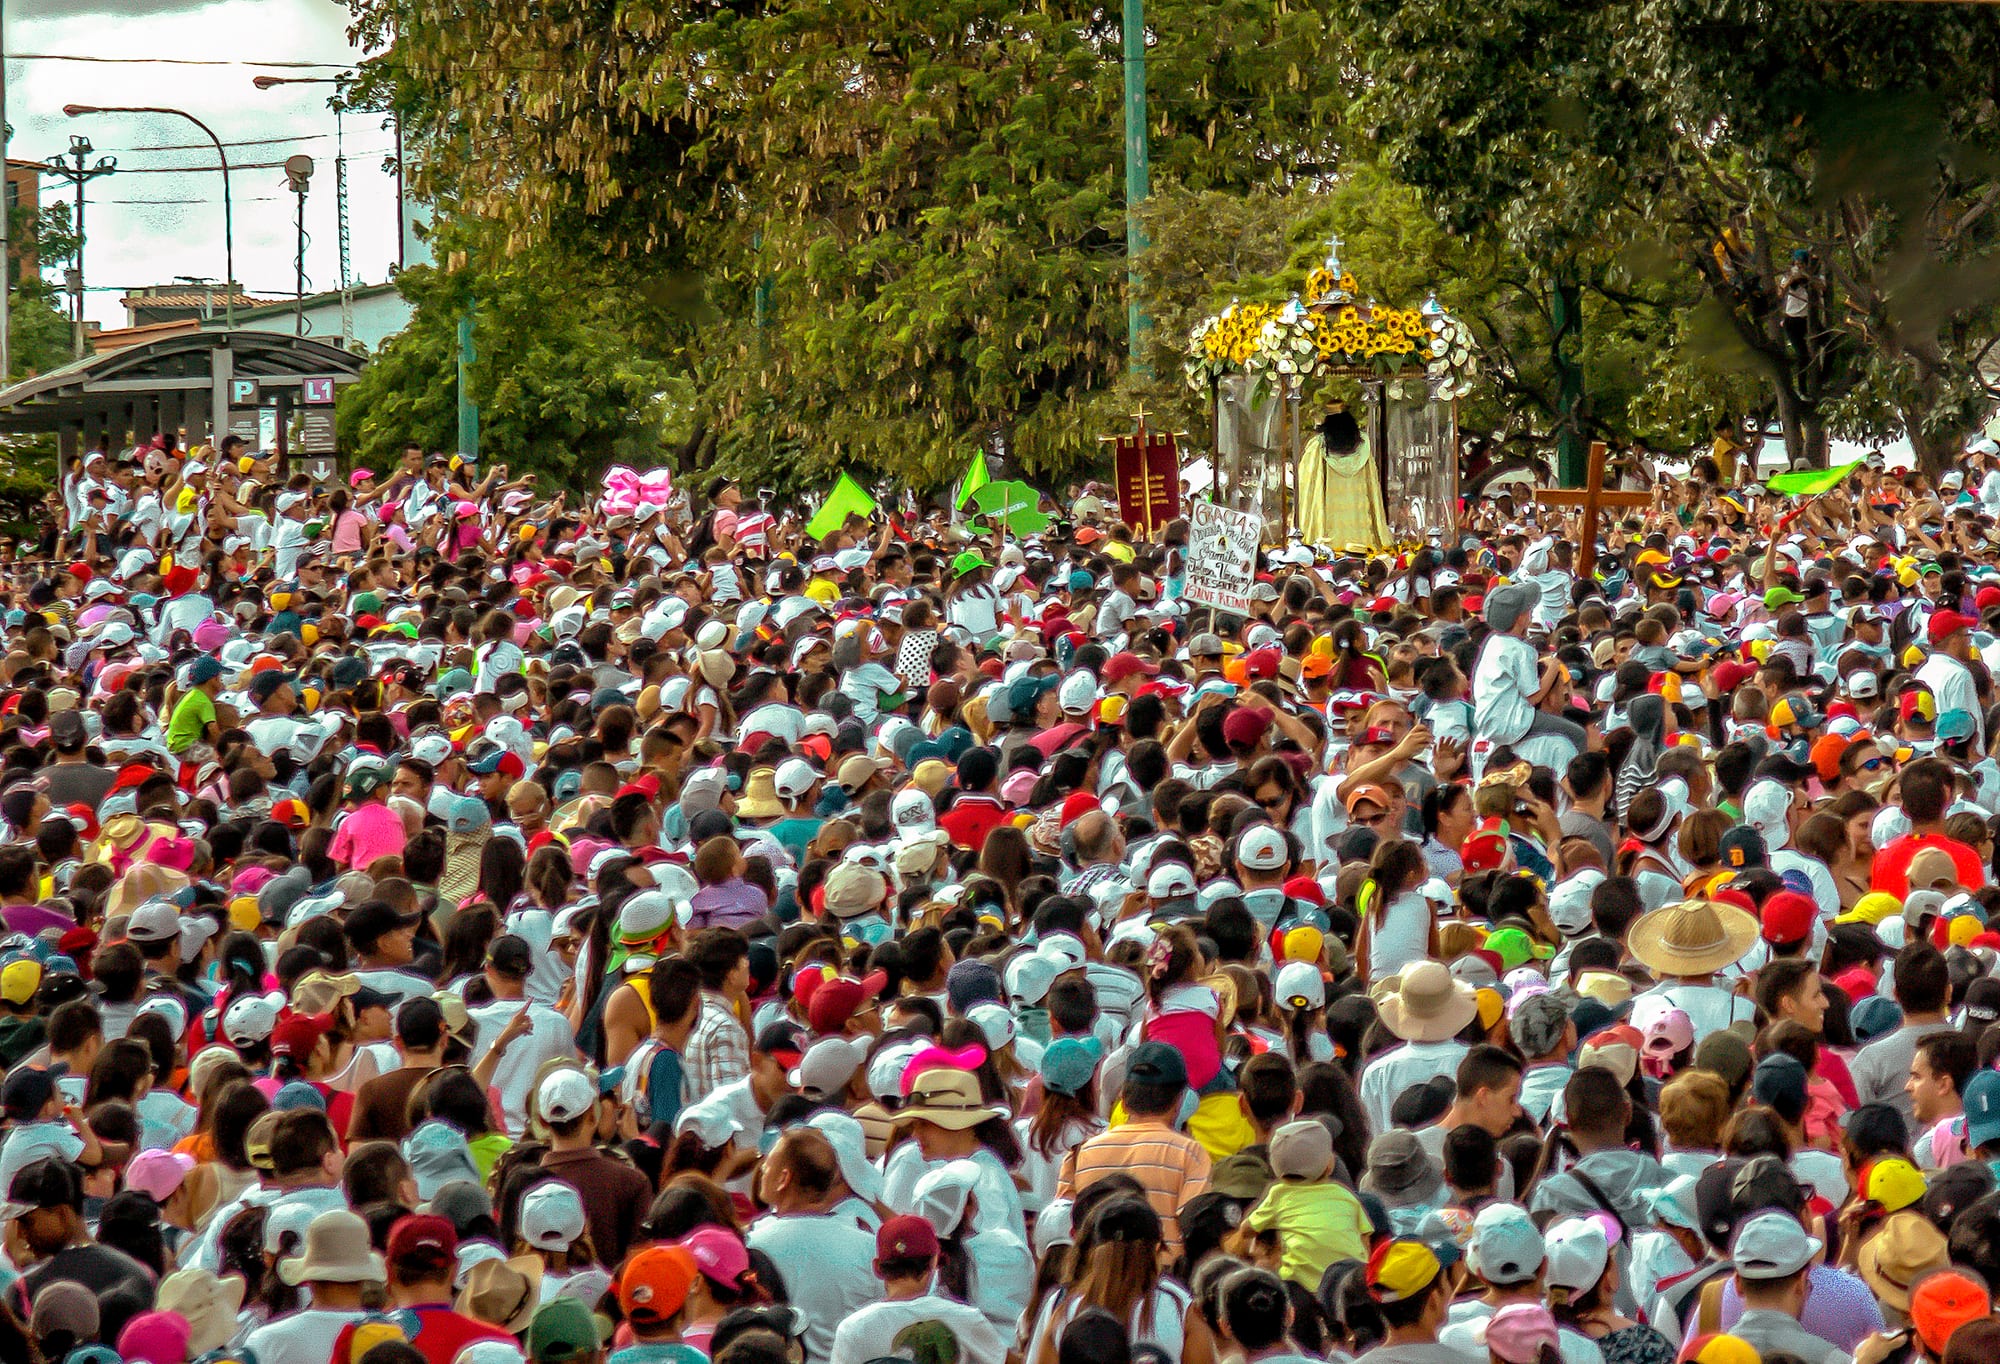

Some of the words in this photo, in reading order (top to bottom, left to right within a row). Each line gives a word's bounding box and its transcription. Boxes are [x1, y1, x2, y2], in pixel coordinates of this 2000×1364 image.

[234, 381, 254, 403] P
[307, 381, 331, 400] L1
[1196, 503, 1258, 541] GRACIAS
